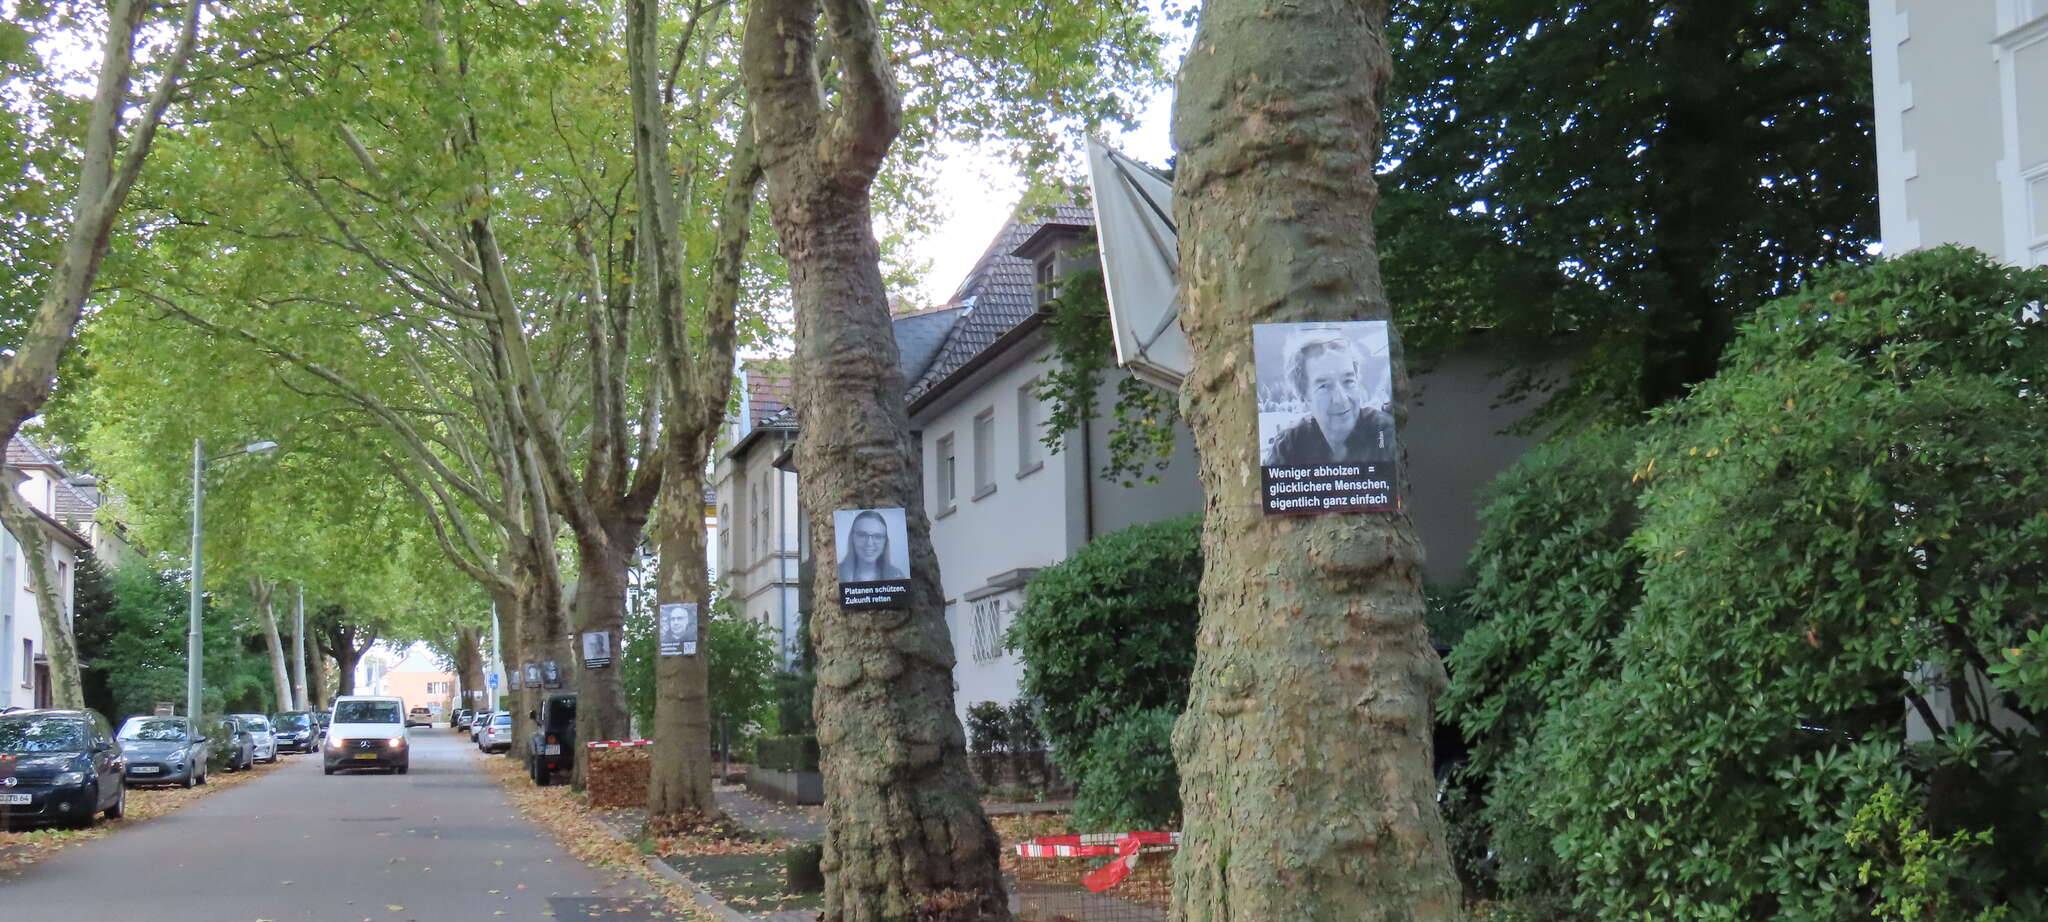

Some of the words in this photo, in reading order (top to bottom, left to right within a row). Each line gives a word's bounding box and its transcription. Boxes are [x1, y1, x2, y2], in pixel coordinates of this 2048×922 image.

[1269, 468, 1311, 479] Weniger
[1314, 465, 1360, 477] abholzen
[1270, 482, 1332, 495] glücklichere
[1334, 479, 1390, 491] Menschen,
[1270, 496, 1320, 510] eigentlich
[1323, 497, 1347, 508] ganz
[1350, 493, 1388, 505] einfach
[875, 585, 906, 593] schützen,
[845, 595, 871, 604] Zukunft
